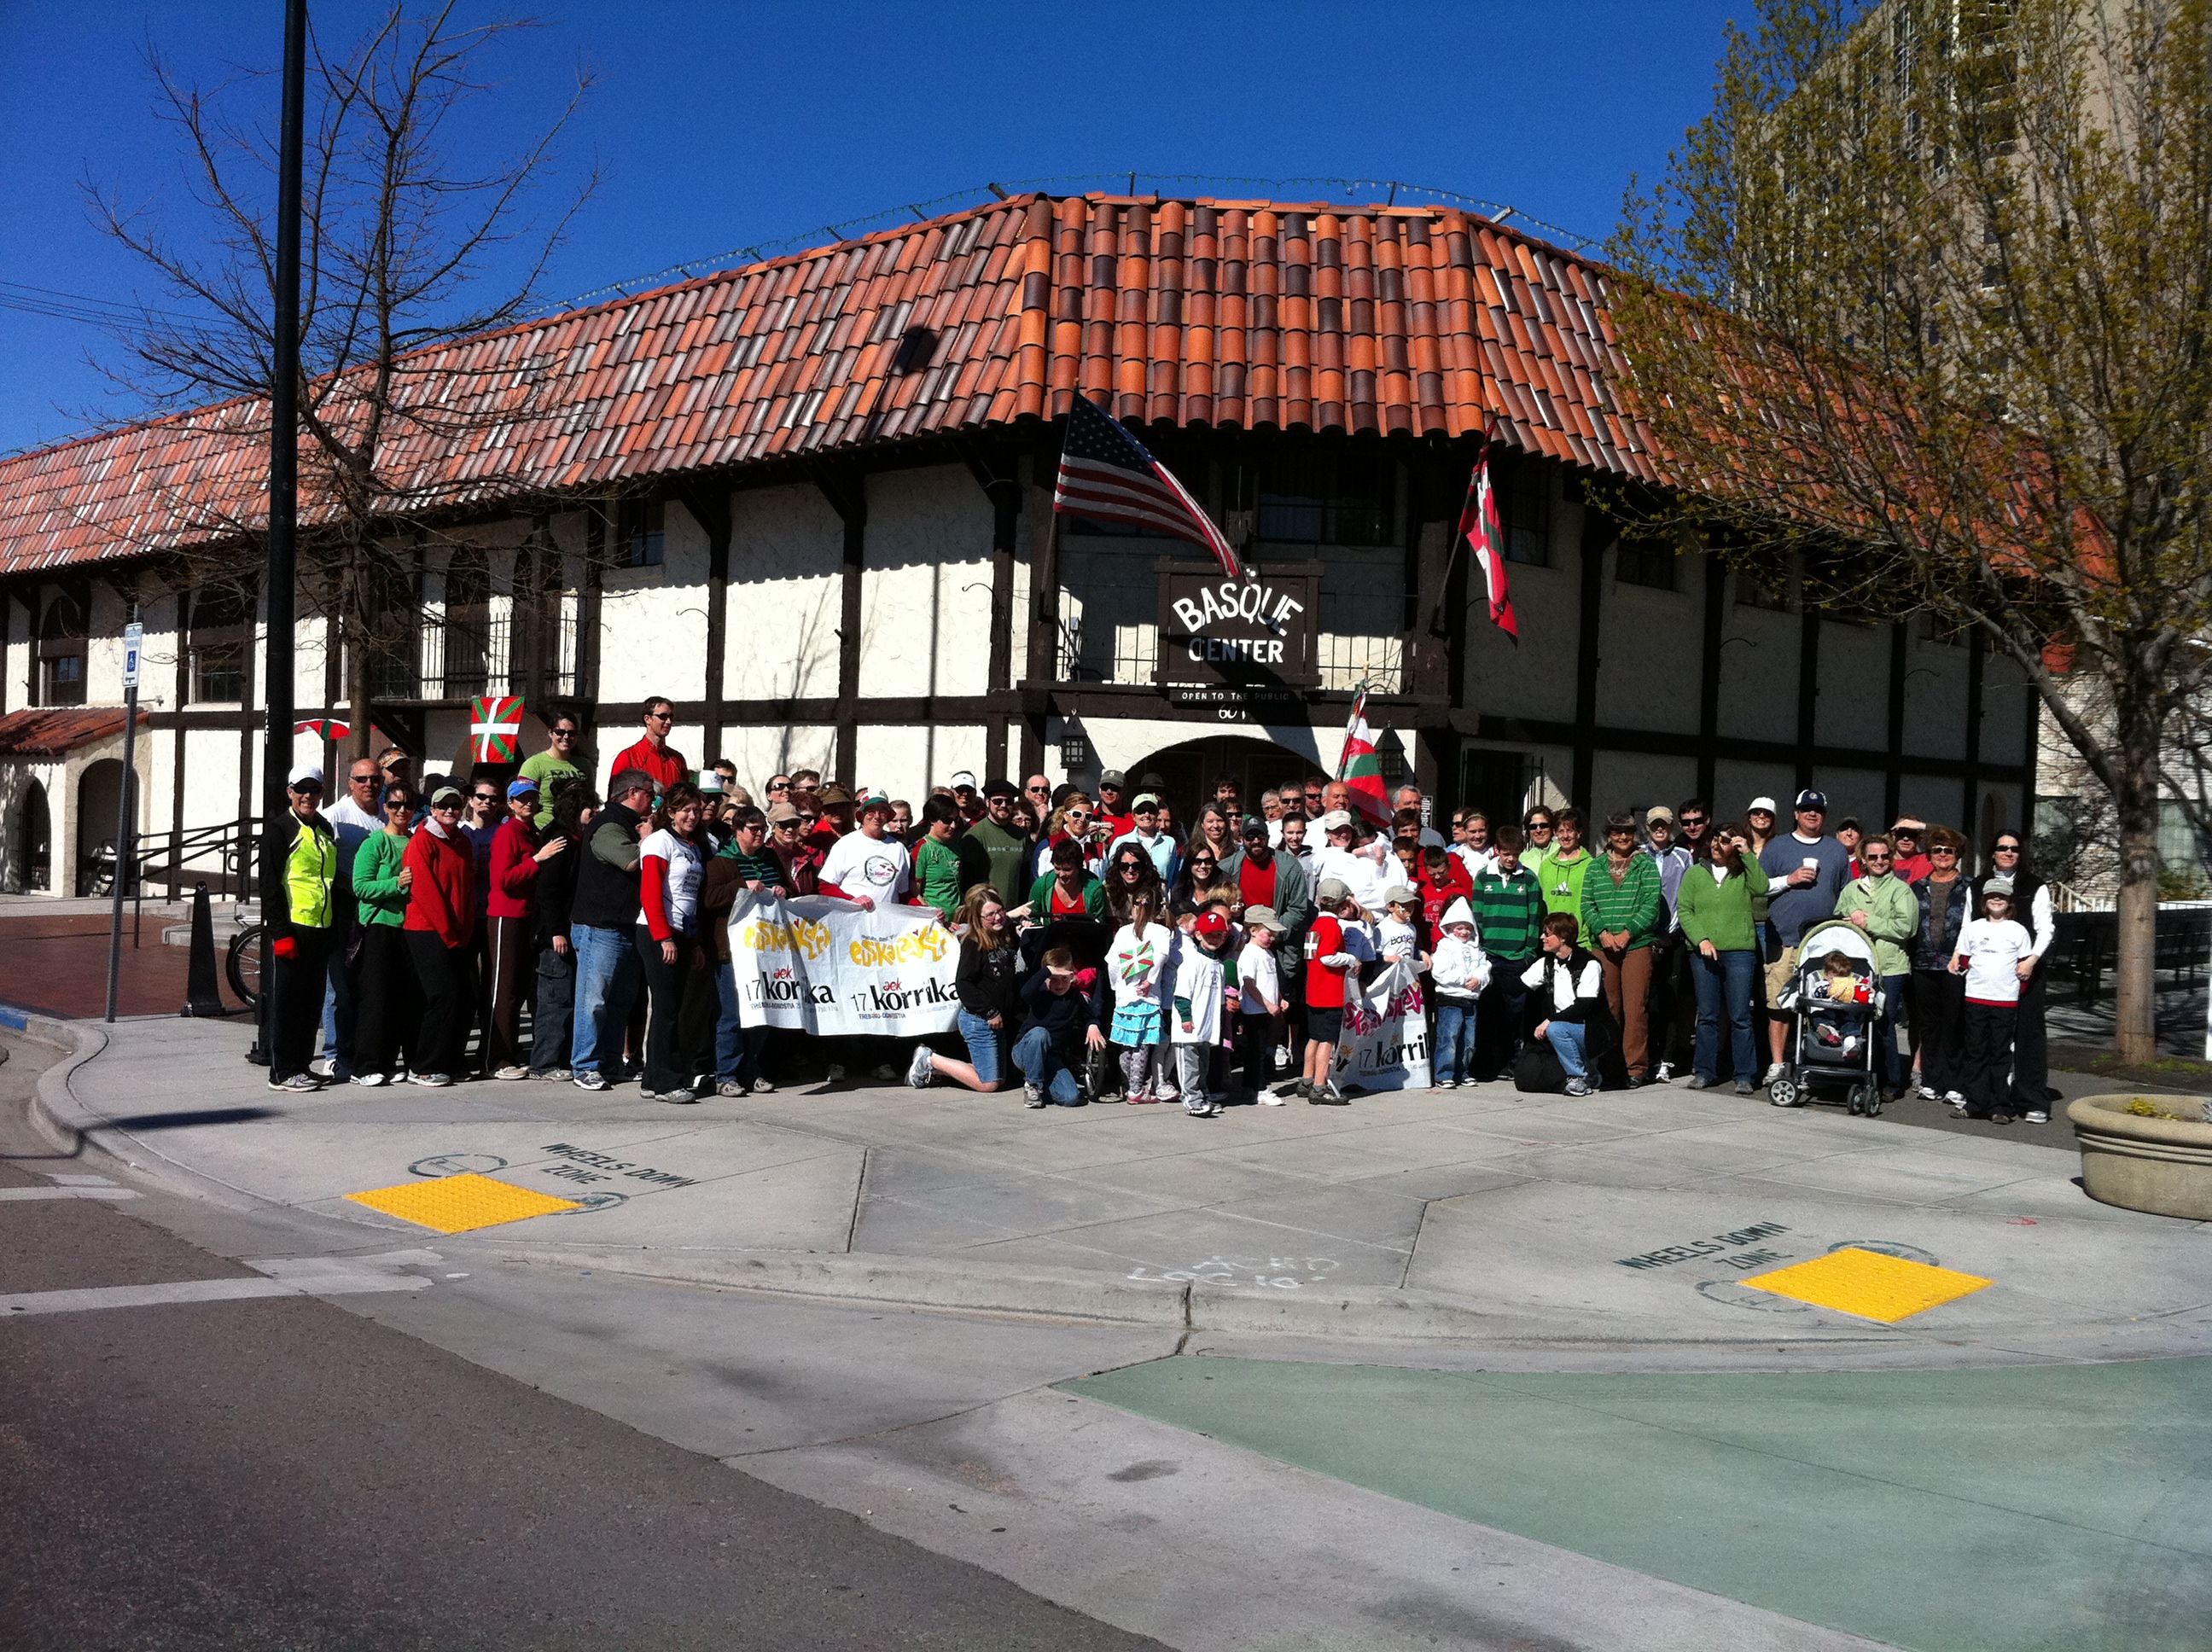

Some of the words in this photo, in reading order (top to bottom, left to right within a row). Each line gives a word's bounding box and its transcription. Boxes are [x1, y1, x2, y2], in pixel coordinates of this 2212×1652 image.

[1173, 582, 1304, 637] BASQUE
[1189, 637, 1284, 663] CENTER
[1218, 703, 1246, 719] 601
[773, 965, 793, 980] aek
[882, 977, 902, 991] aek
[762, 971, 836, 1005] korka
[870, 977, 959, 1011] korrika
[539, 1164, 613, 1184] ZONE
[540, 1143, 637, 1168] WHEELS
[623, 1168, 701, 1189] DOWN
[1612, 1241, 1726, 1270] WHEELS
[1712, 1221, 1792, 1246] DOWN
[1714, 1248, 1794, 1270] ZONE
